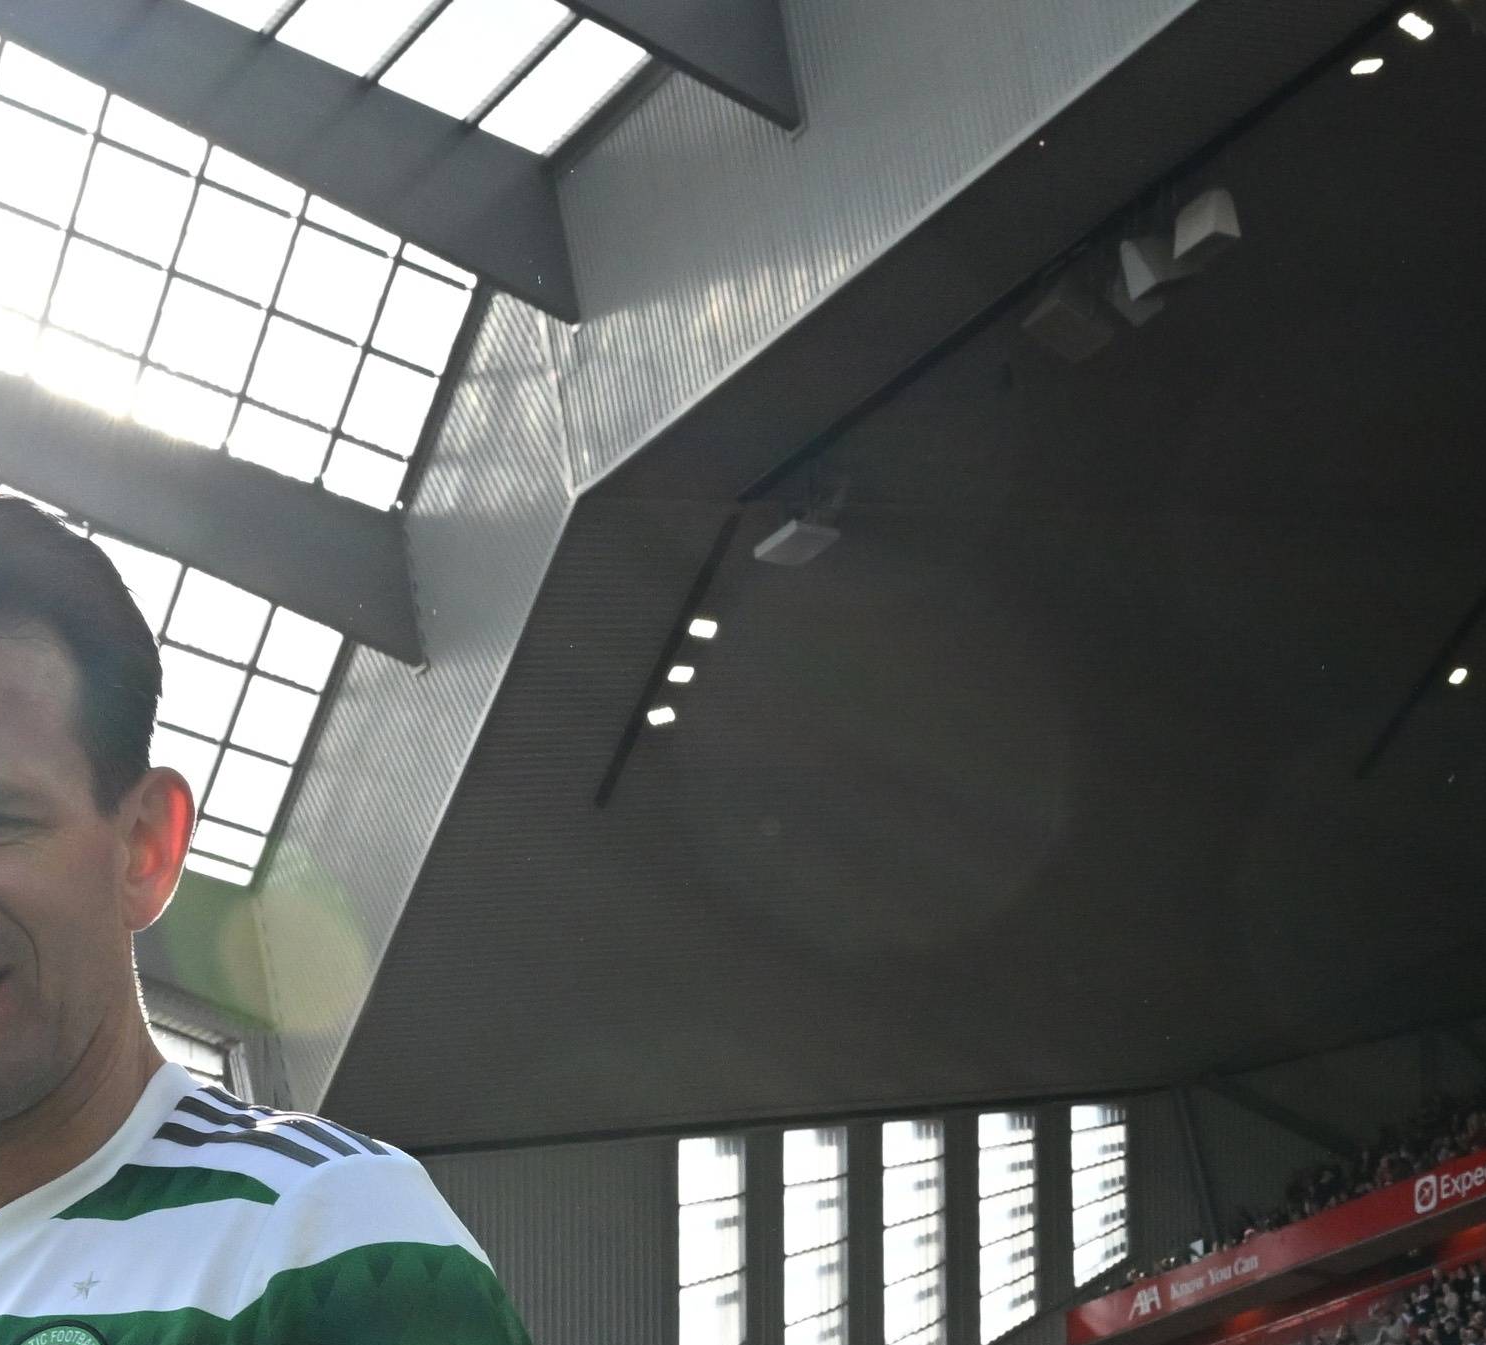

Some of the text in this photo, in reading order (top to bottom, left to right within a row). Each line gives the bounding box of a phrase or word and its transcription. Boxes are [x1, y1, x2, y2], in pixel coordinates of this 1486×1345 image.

[1128, 1255, 1258, 1321] AXA Know You Can
